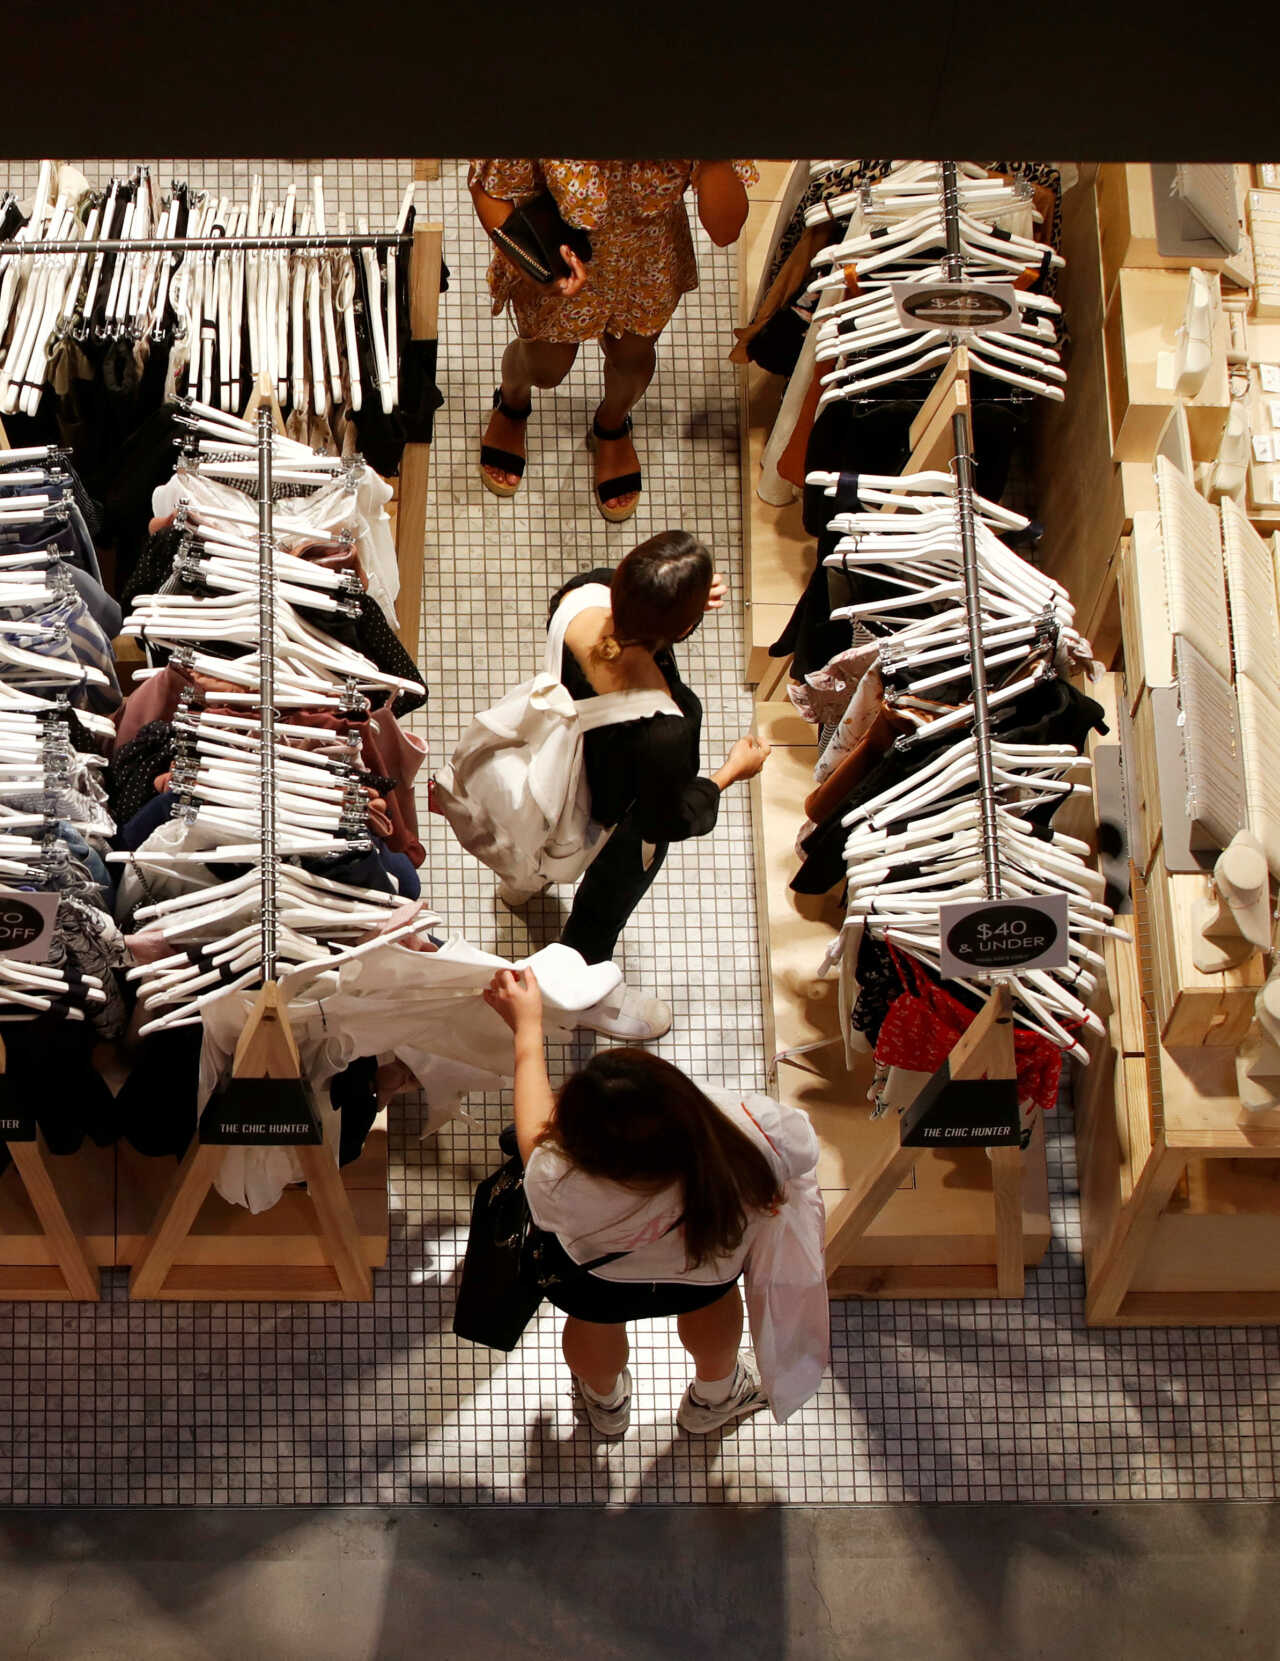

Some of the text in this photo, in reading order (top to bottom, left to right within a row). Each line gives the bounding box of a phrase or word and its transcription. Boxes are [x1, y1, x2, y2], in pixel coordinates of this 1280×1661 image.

[930, 297, 981, 309] $45
[976, 920, 1027, 940] $40
[958, 936, 1045, 954] & UNDER
[220, 1123, 309, 1133] THE CHIC HUNTER
[923, 1126, 1011, 1137] THE CHIC HUNTER
